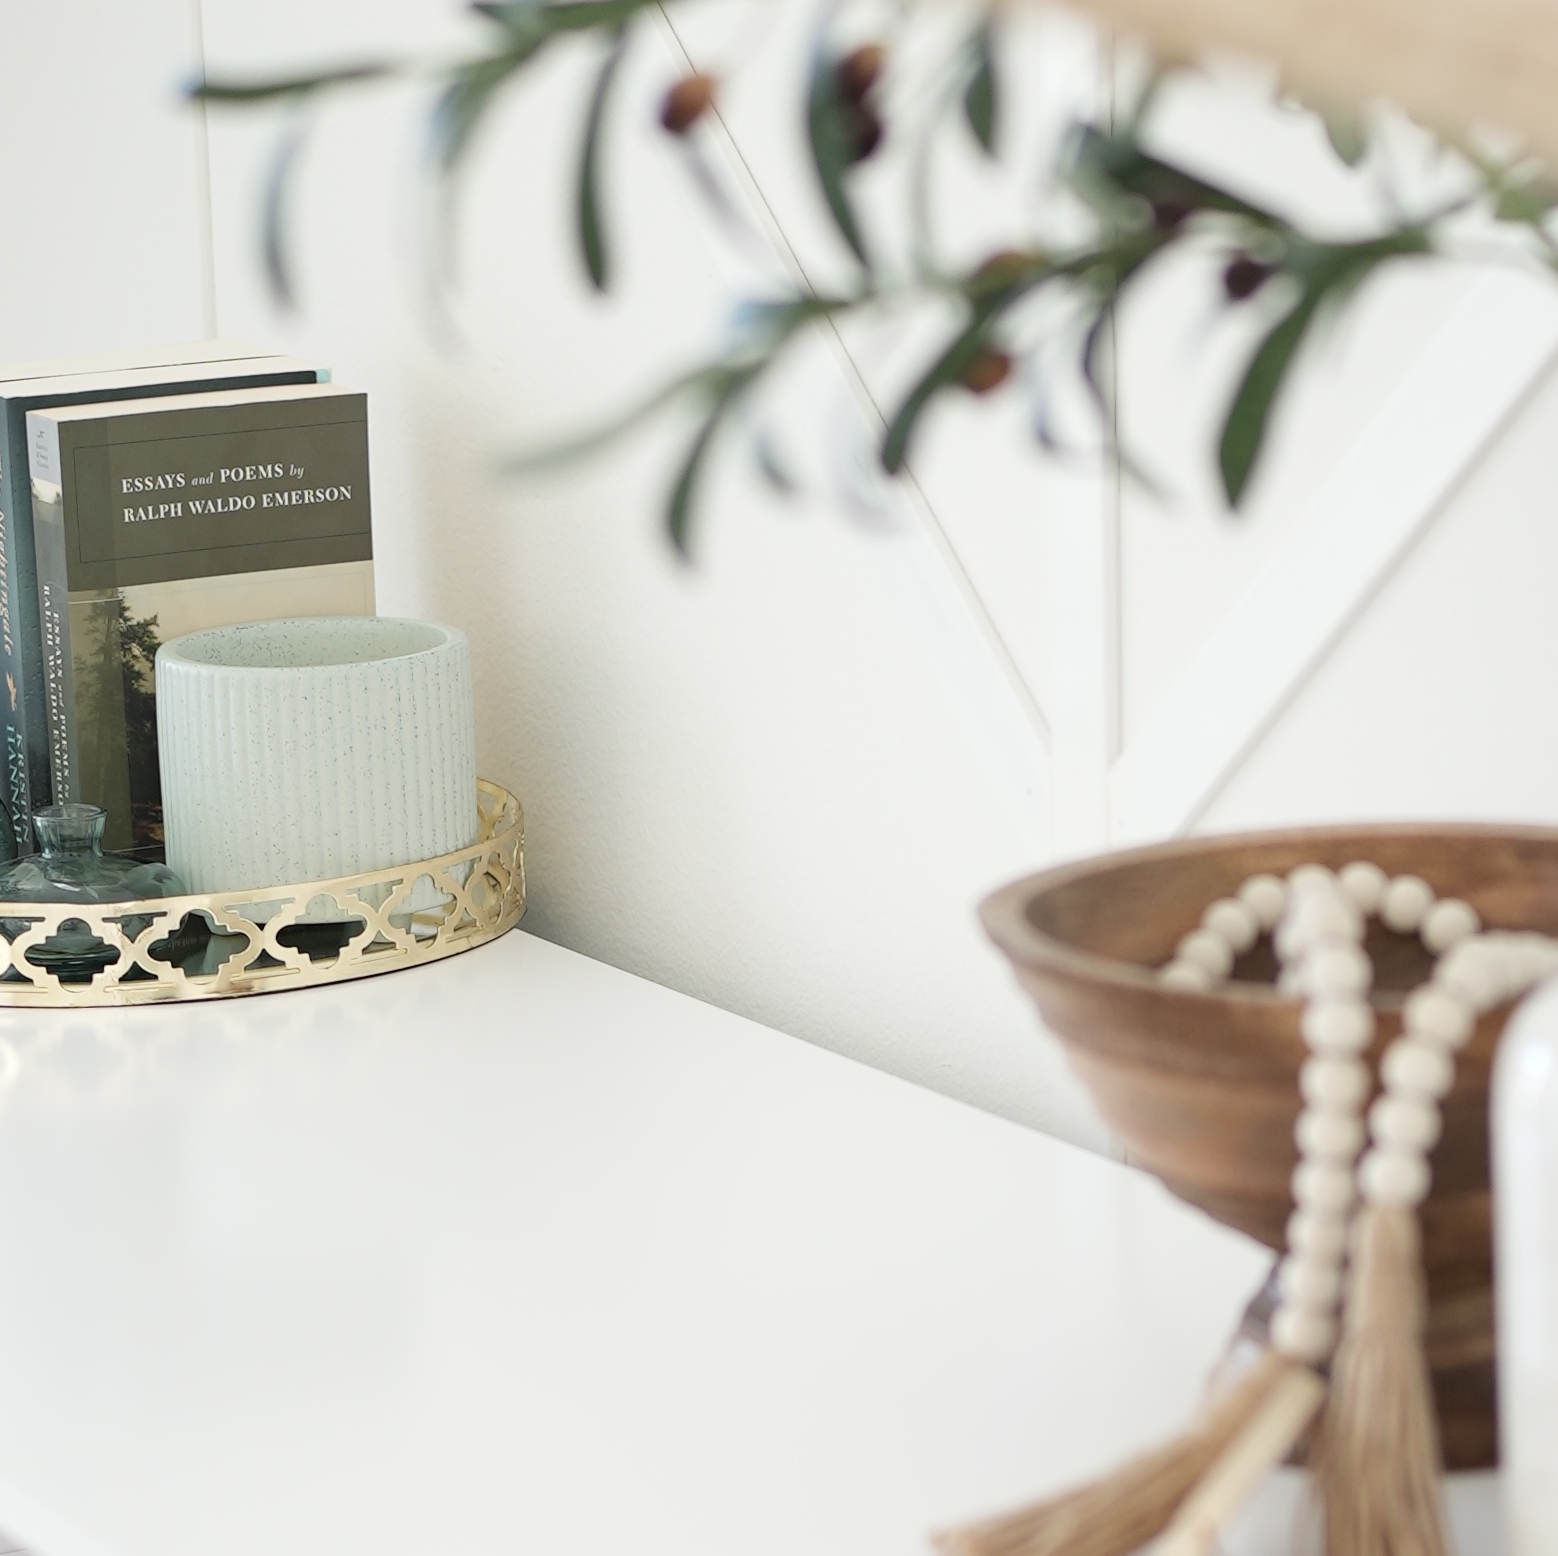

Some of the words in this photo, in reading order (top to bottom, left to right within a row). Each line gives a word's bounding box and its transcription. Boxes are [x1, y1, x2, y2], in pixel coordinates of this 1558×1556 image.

[121, 473, 186, 494] ESSAYS
[191, 472, 214, 487] and
[219, 462, 285, 484] POEMS
[289, 463, 305, 479] by
[123, 500, 183, 523] RALPH
[188, 495, 256, 516] WALDO
[261, 485, 353, 509] EMERSON
[6, 724, 23, 844] HANNAH
[53, 729, 64, 806] EMERSO
